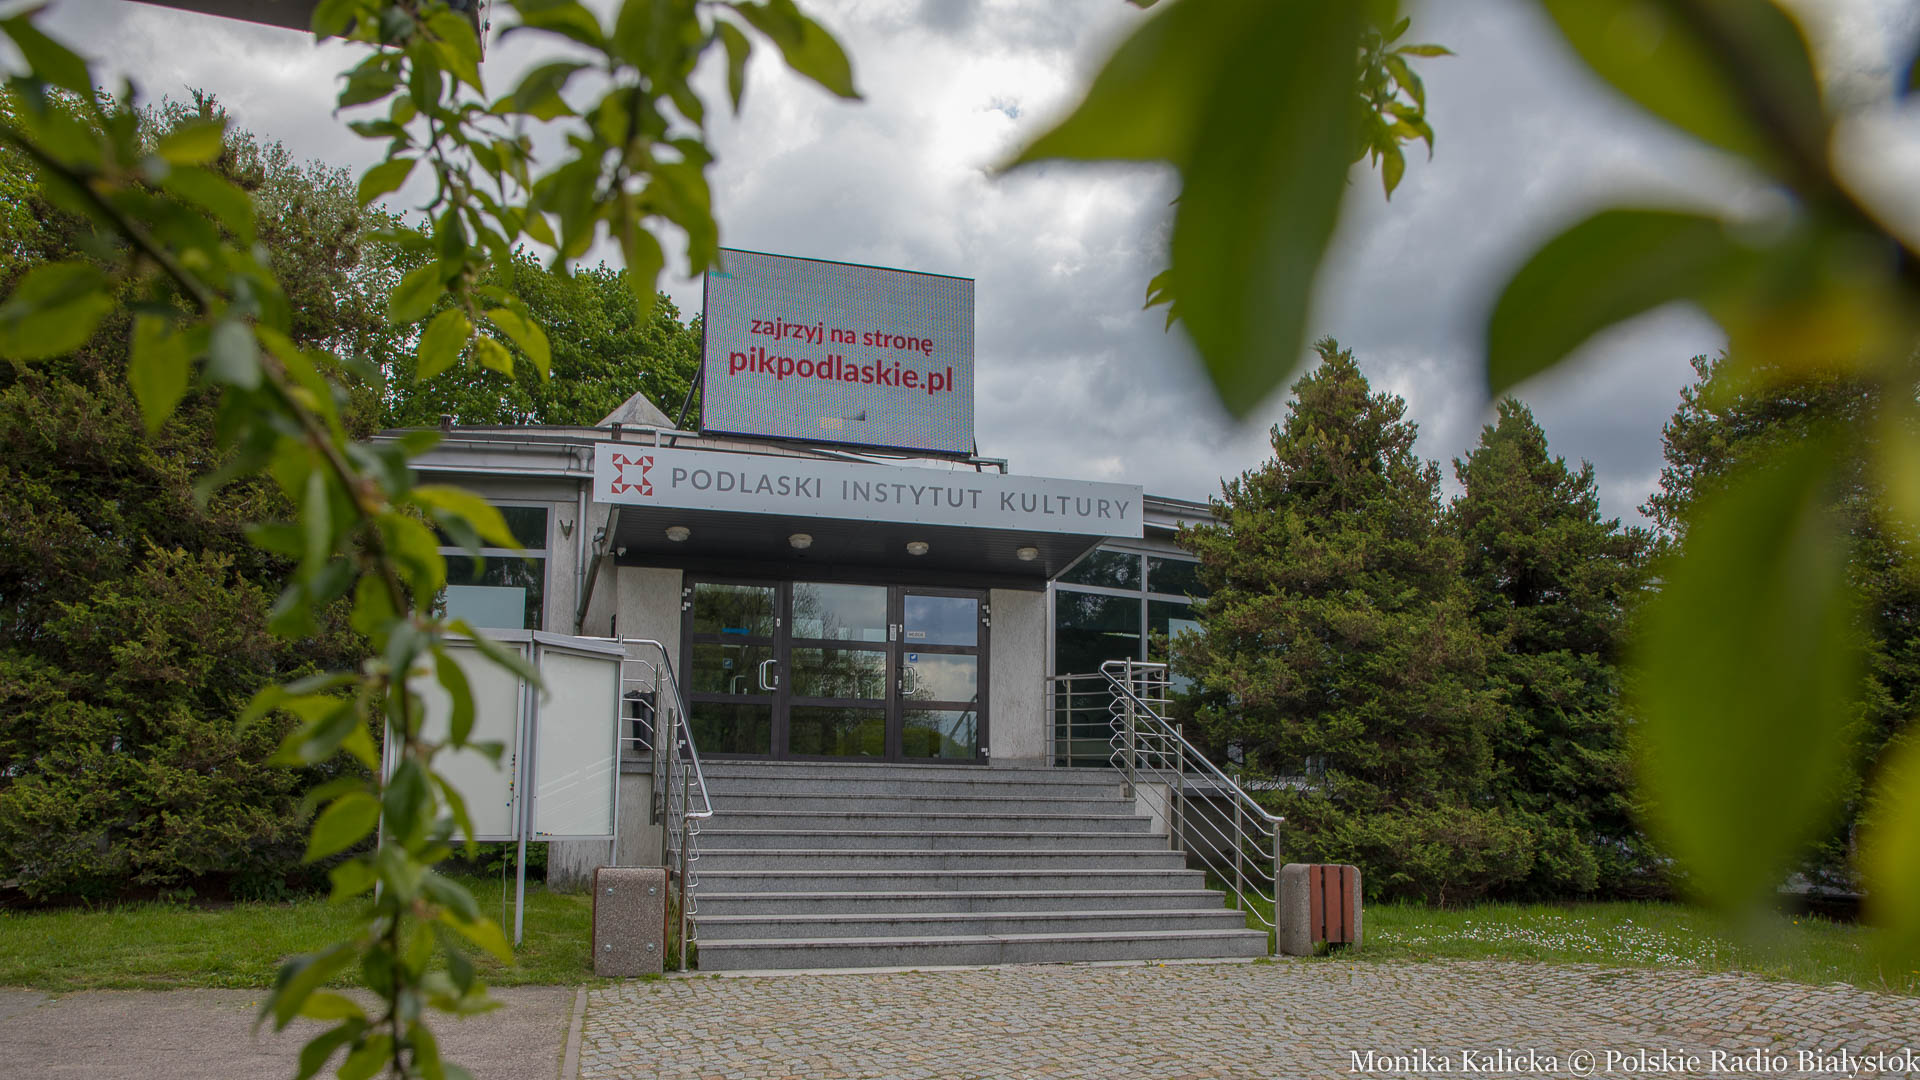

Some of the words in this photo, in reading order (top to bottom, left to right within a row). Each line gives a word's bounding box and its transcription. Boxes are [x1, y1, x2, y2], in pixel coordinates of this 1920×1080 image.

[750, 317, 824, 346] zajrzyj
[830, 328, 857, 346] na
[862, 330, 934, 357] stronę
[728, 346, 953, 396] pikpodlaskie.pl
[671, 467, 822, 499] PODLASKI
[842, 480, 983, 511] INSTYTUT
[1000, 491, 1130, 520] KULTURY
